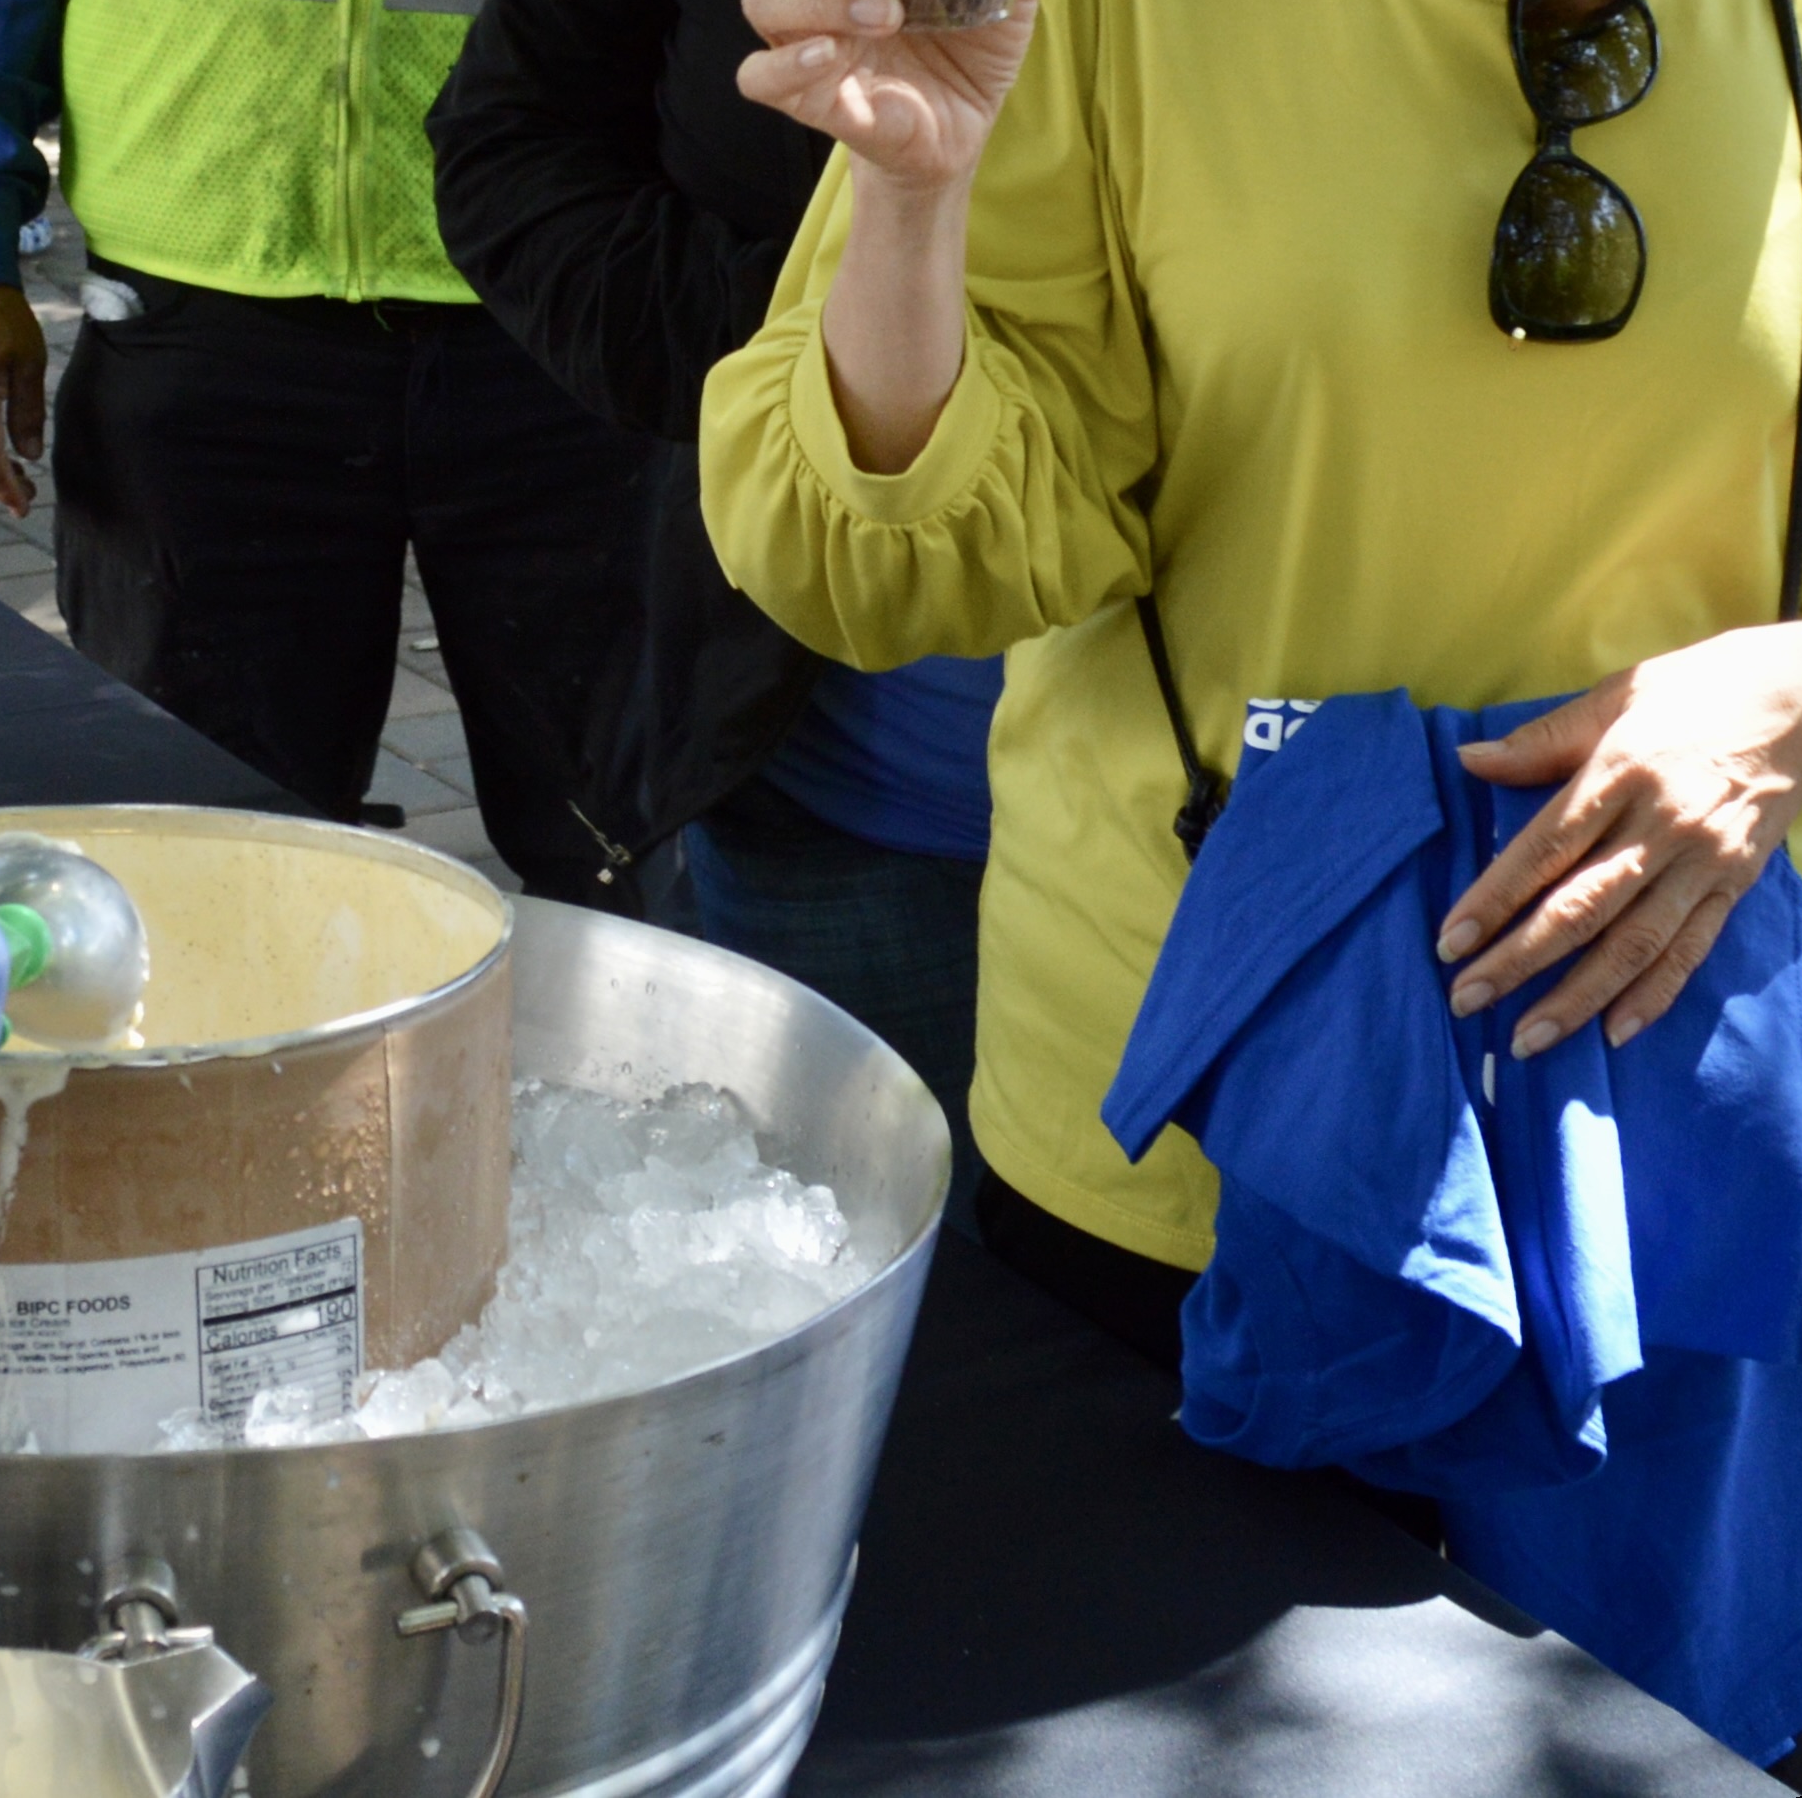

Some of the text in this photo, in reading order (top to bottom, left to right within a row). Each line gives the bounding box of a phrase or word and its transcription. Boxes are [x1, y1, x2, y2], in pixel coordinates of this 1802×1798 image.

[213, 1244, 342, 1285] Nutrition Facts
[17, 1300, 61, 1315] BIPC
[66, 1295, 131, 1314] FOODS
[207, 1324, 278, 1351] Calories
[317, 1298, 354, 1326] 190
